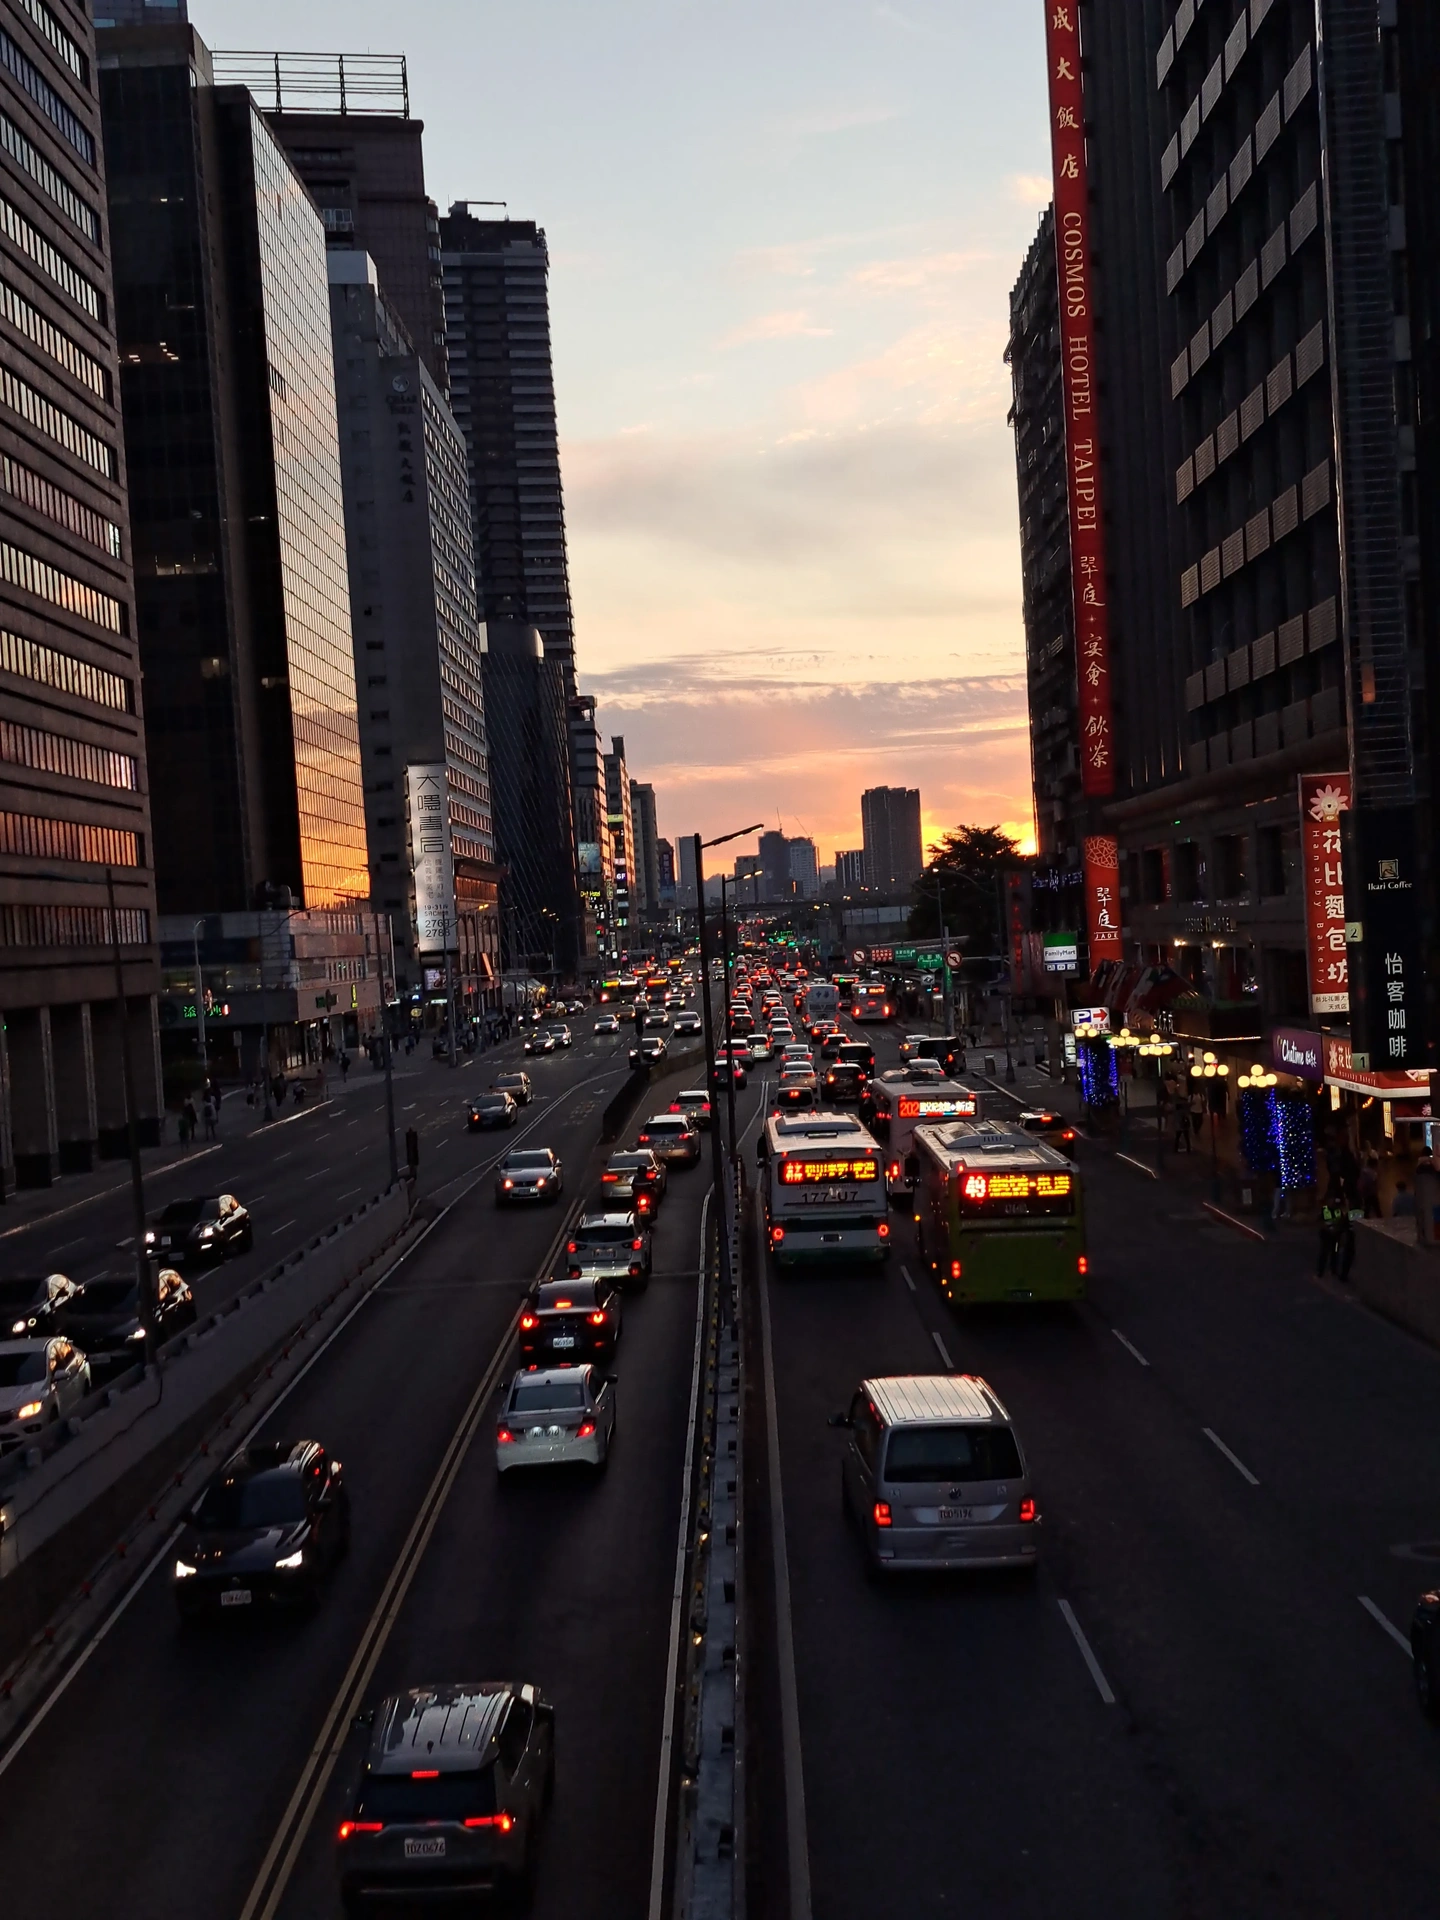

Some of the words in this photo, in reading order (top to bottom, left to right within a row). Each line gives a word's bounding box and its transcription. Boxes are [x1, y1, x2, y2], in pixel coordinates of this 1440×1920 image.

[1052, 5, 1080, 179] 成大飯店
[1063, 212, 1086, 318] COSMOS
[1069, 335, 1091, 421] HOTEL
[1073, 438, 1097, 531] TAIPEI
[1085, 715, 1109, 769] 飲茶
[1312, 830, 1322, 907] Hanabby
[1367, 882, 1386, 891] Ikari
[1388, 880, 1413, 889] Coffee
[1350, 928, 1358, 939] 2
[1045, 949, 1076, 957] FamilyMart
[1316, 922, 1324, 985] Bakery
[1073, 1011, 1090, 1024] P
[1384, 952, 1407, 1058] 怡客咖啡
[1282, 1039, 1304, 1066] Chatime
[1360, 1056, 1366, 1068] 1
[900, 1101, 919, 1117] 202
[801, 1191, 859, 1203] 177-U7
[965, 1175, 986, 1198] 49
